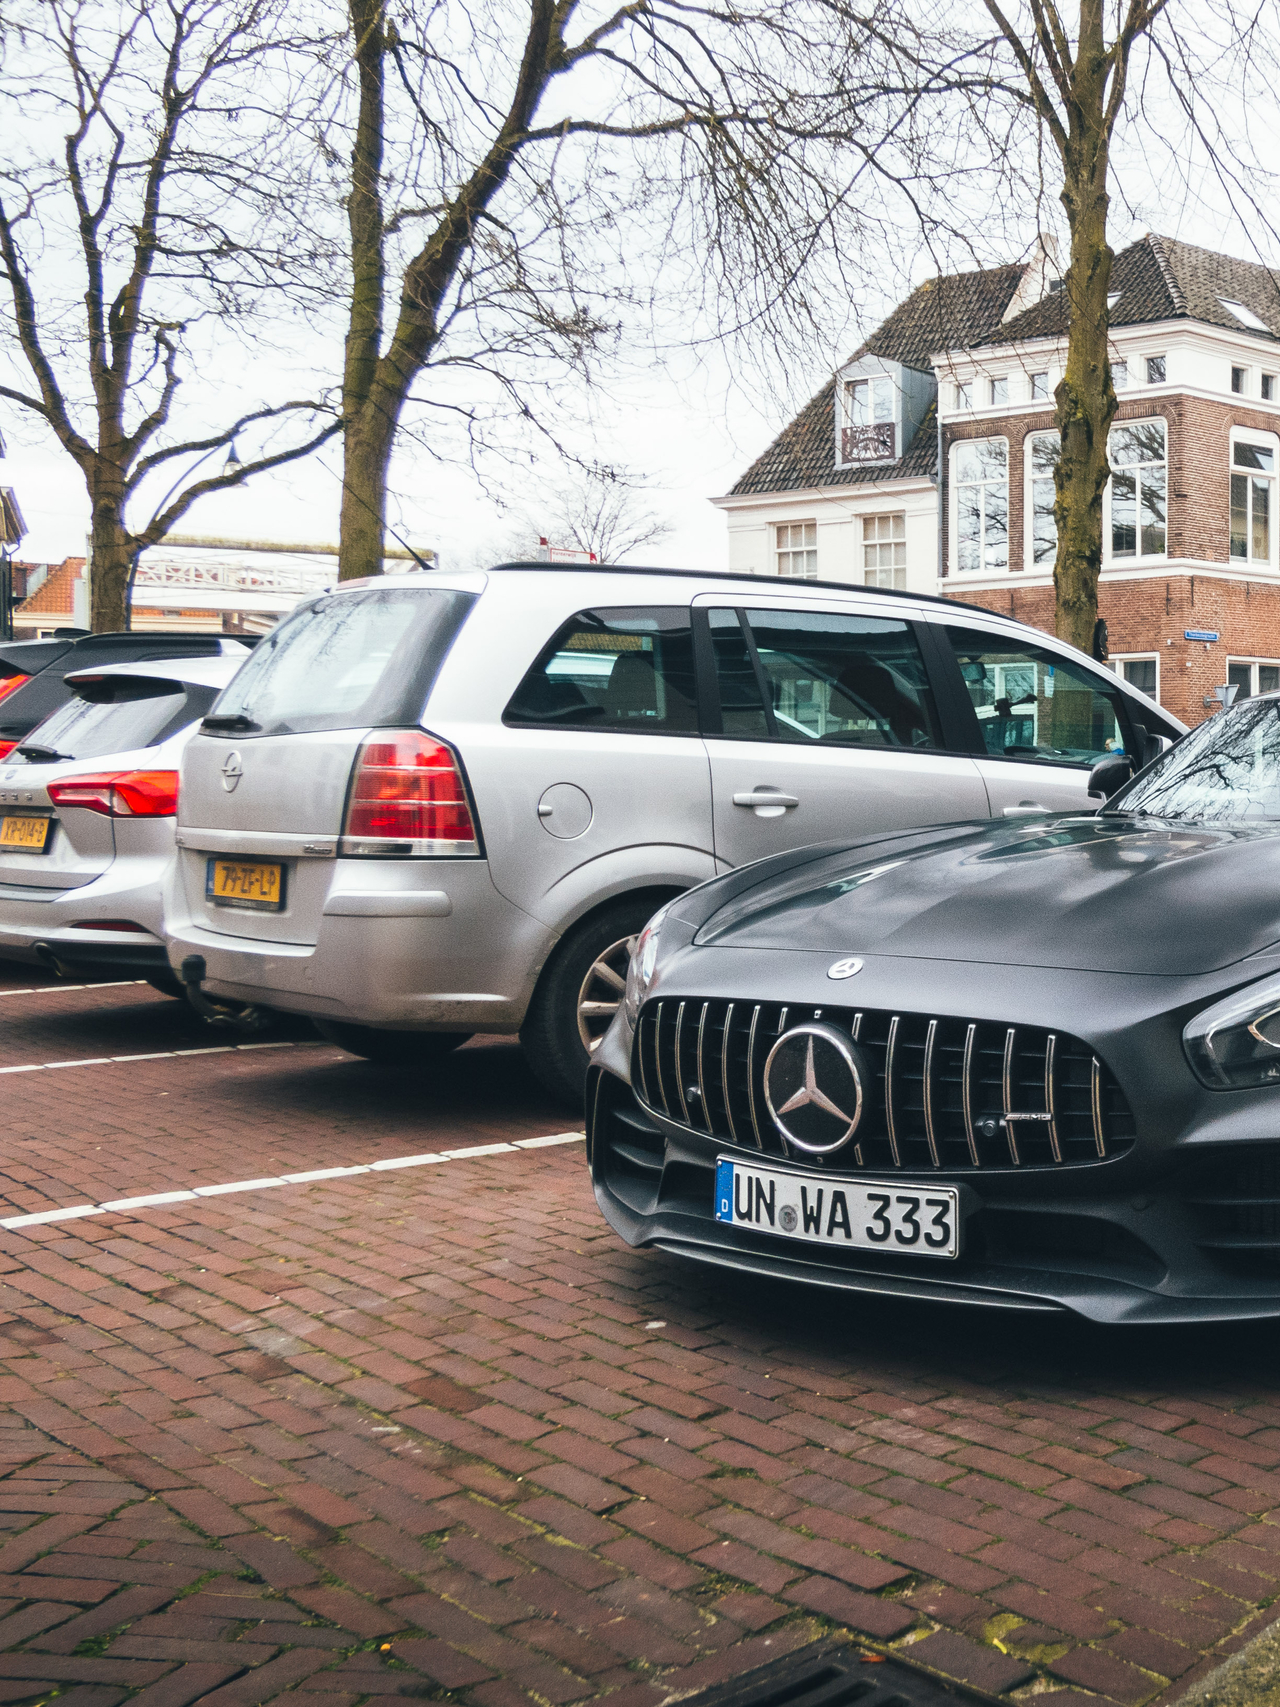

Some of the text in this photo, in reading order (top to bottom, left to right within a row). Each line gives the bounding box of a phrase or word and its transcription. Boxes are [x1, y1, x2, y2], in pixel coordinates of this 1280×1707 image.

[721, 1198, 729, 1213] D
[734, 1172, 950, 1248] UN WA 333
